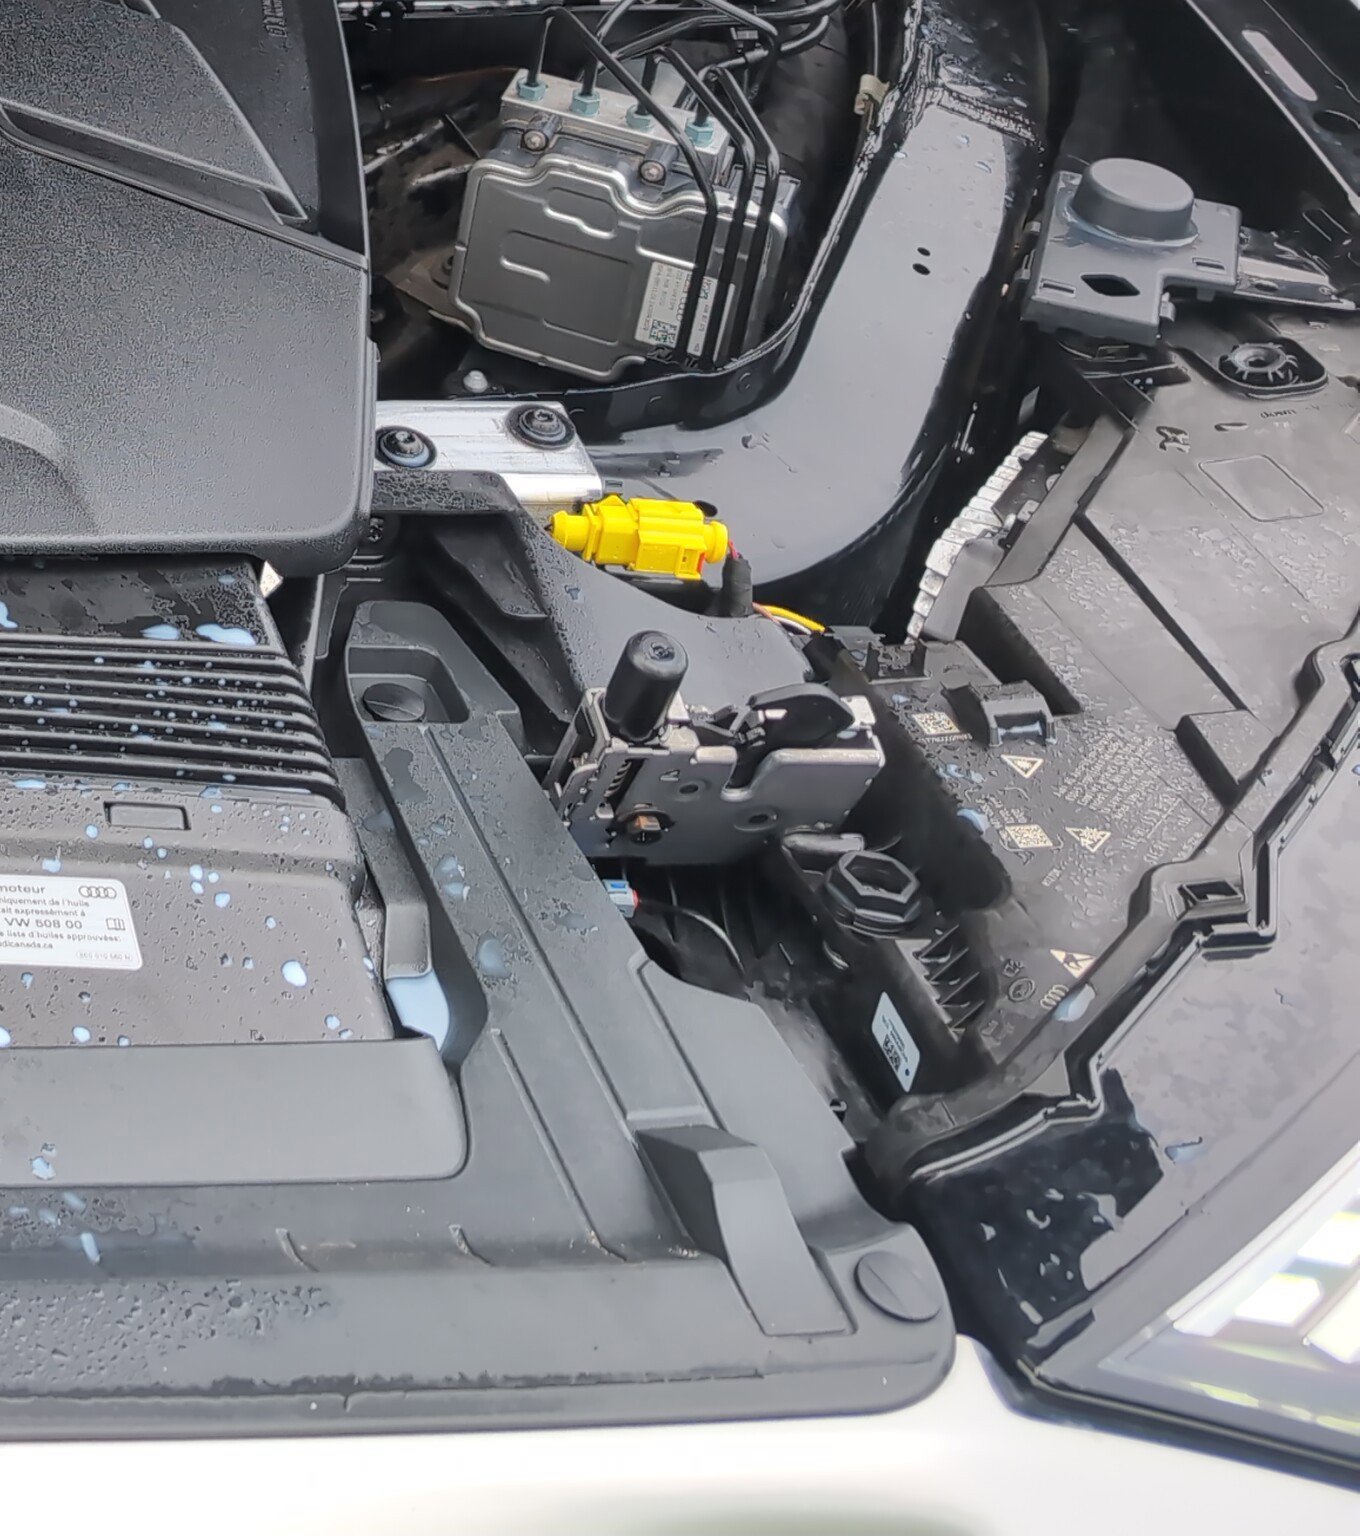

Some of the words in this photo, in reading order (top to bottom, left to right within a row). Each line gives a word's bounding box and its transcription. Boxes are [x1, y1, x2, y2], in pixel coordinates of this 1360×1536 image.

[5, 918, 30, 927] VW
[35, 919, 61, 928] 508
[65, 920, 83, 929] 00
